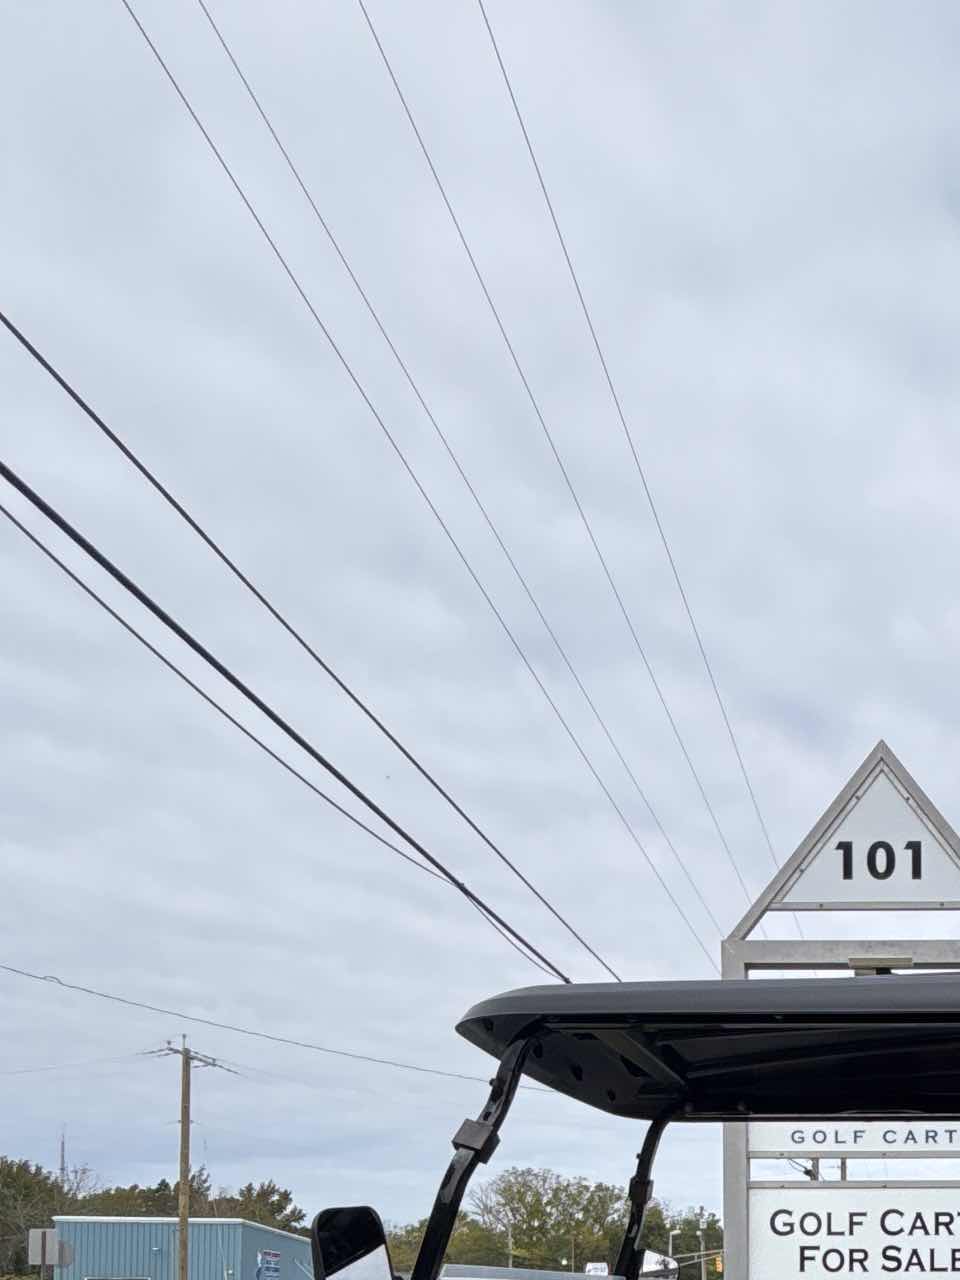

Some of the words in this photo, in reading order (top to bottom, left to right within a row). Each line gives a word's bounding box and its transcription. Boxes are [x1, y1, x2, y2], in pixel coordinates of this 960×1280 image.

[834, 841, 923, 880] 101
[791, 1130, 865, 1144] GOLF
[770, 1209, 867, 1236] GOLF
[799, 1245, 869, 1273] FOR
